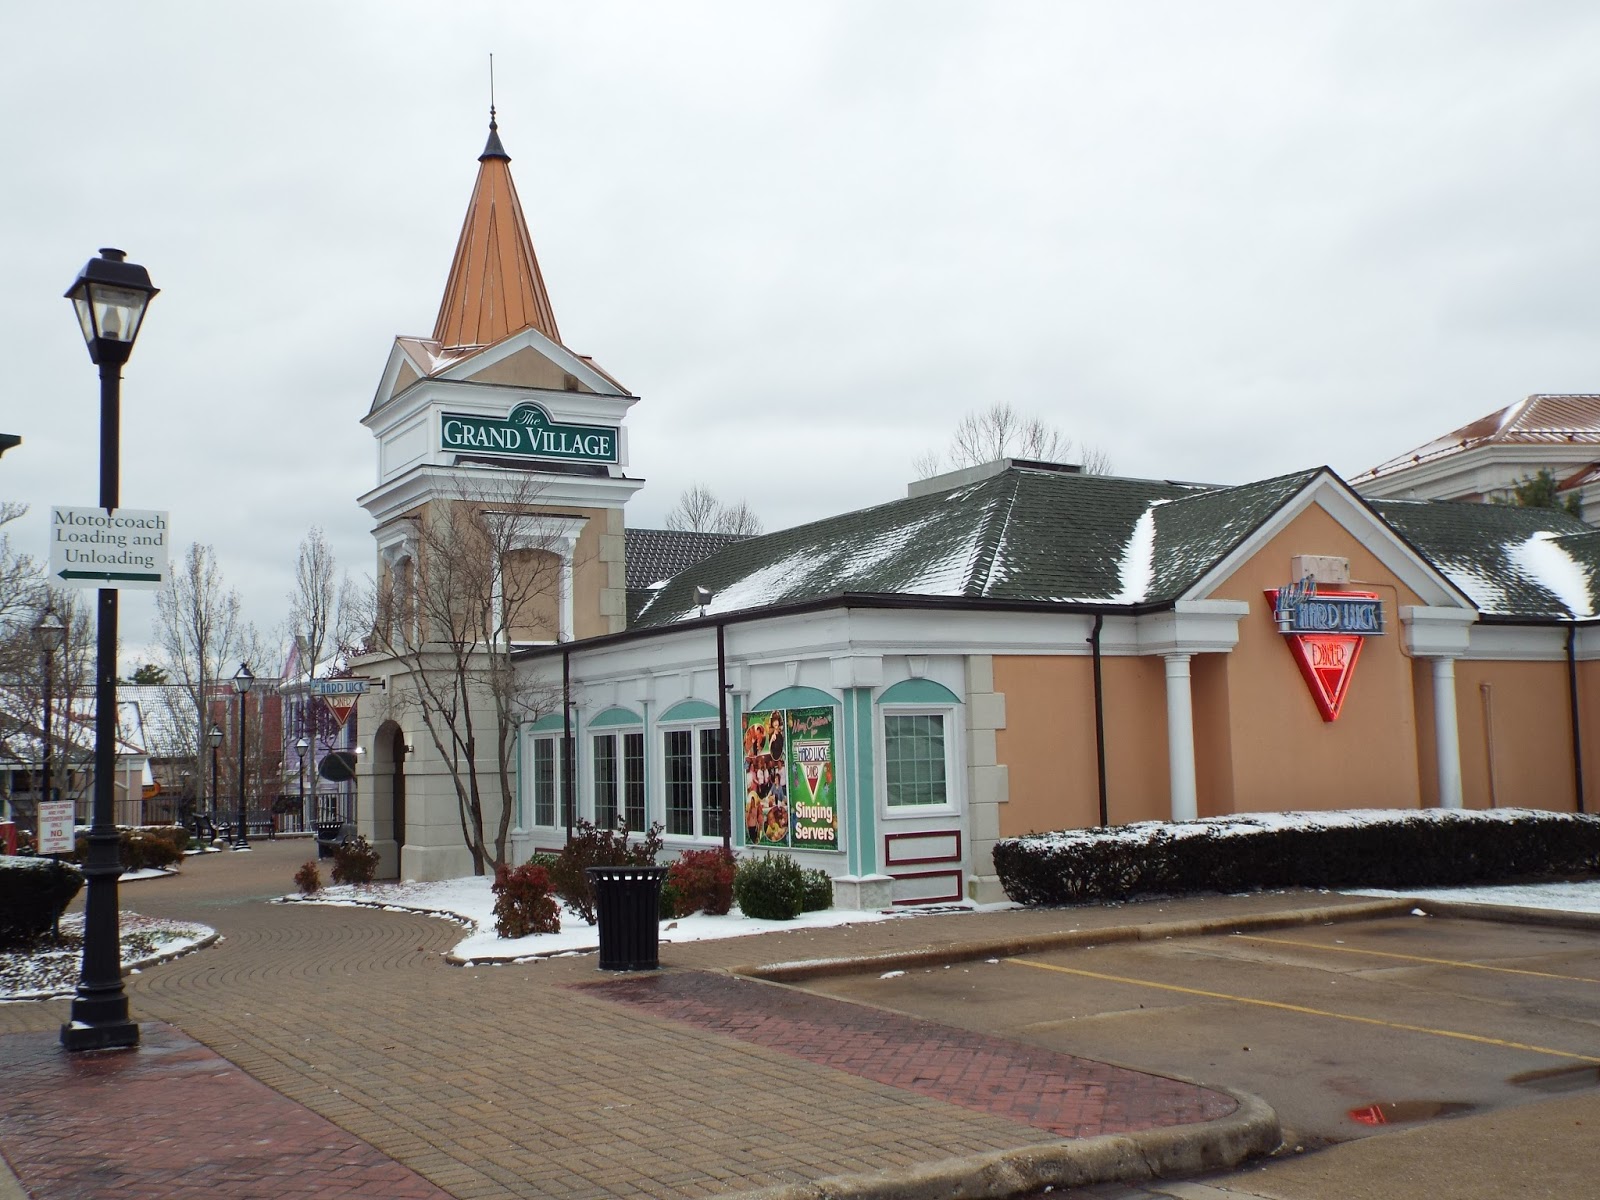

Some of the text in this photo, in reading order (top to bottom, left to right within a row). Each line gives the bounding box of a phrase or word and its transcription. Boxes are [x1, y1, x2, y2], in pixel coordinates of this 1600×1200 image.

[515, 409, 541, 426] The
[443, 420, 611, 456] GRAND VILLAGE
[54, 510, 166, 530] Motorcoach
[56, 528, 163, 549] Loading and
[65, 548, 155, 569] Unloading
[1299, 602, 1378, 631] HARD LUCK
[1311, 643, 1349, 668] DINER
[321, 682, 344, 694] HARD
[345, 681, 365, 693] LUCK
[798, 746, 828, 761] HARD LUCK
[795, 801, 833, 824] Singing
[50, 829, 63, 837] NO
[795, 822, 834, 841] Servers
